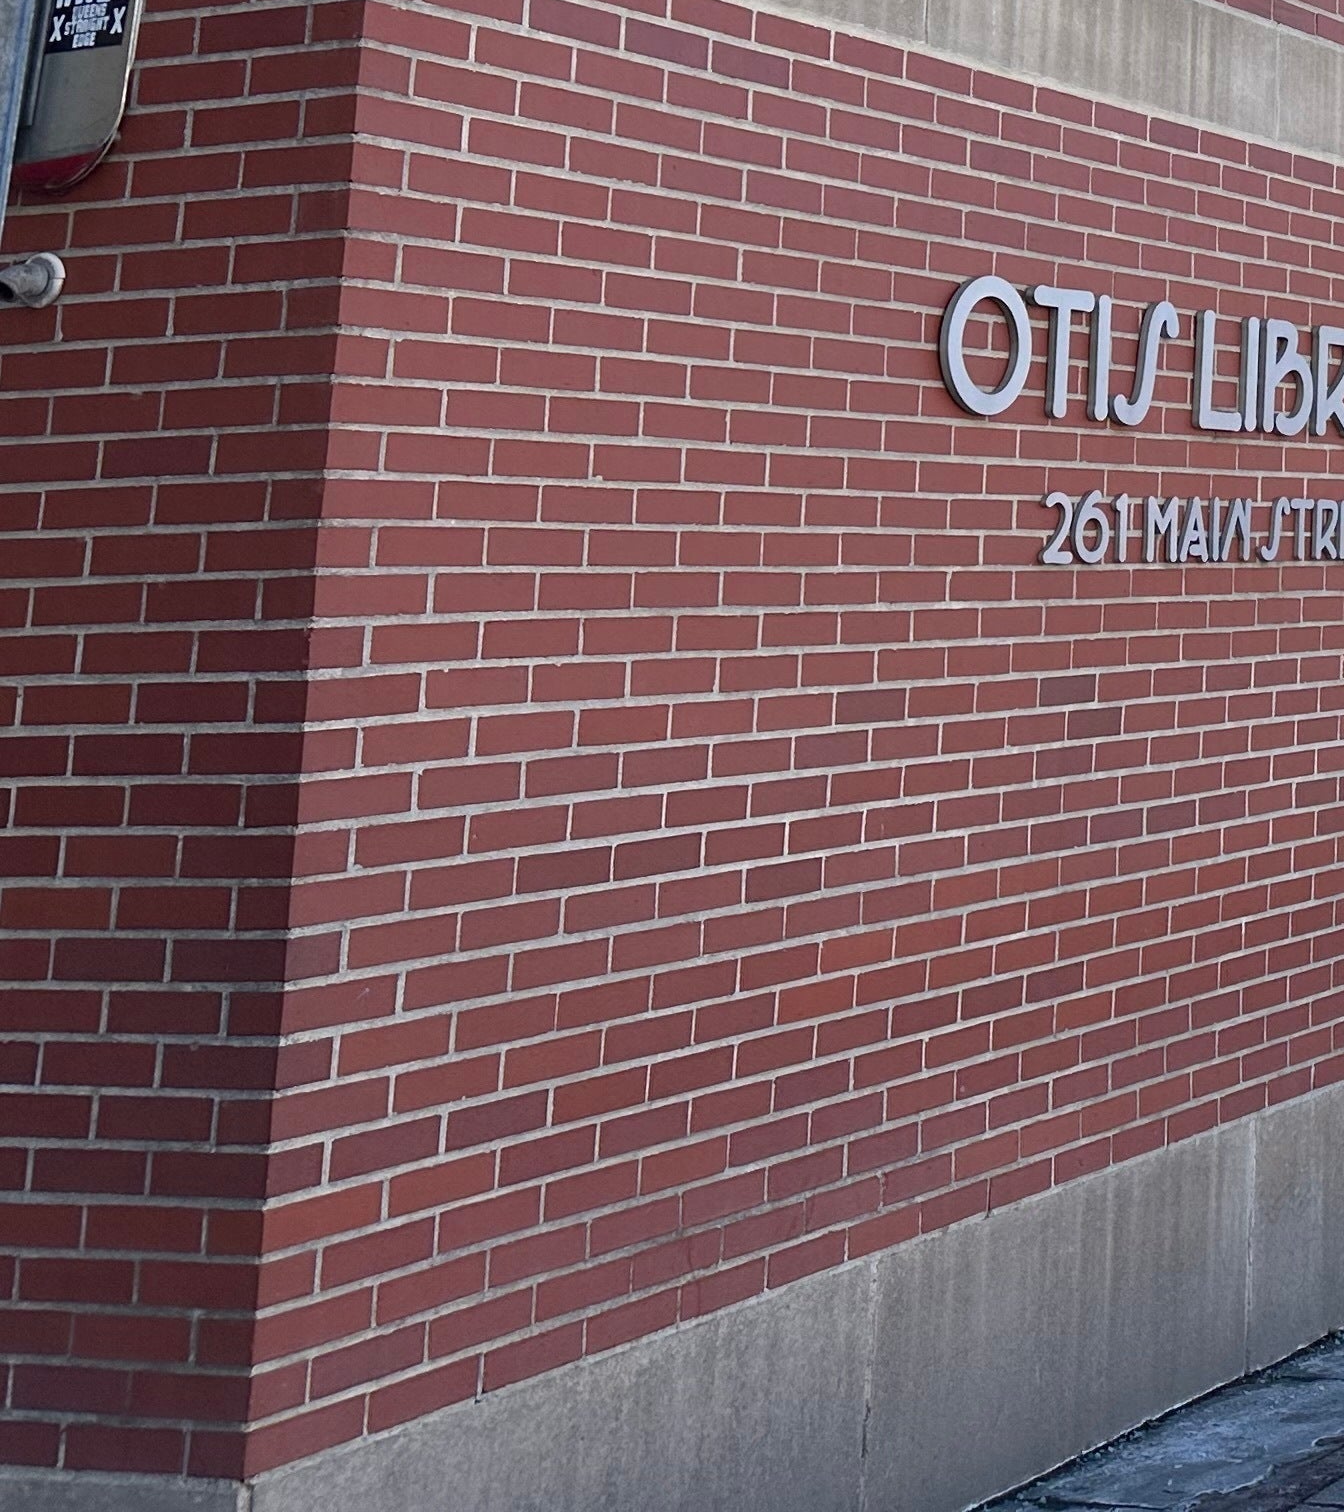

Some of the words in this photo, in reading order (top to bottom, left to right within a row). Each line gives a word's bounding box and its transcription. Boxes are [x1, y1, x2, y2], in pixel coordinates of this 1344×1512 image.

[939, 274, 1180, 426] OTIS
[1039, 490, 1128, 565] 261
[1143, 496, 1252, 564] MAIN
